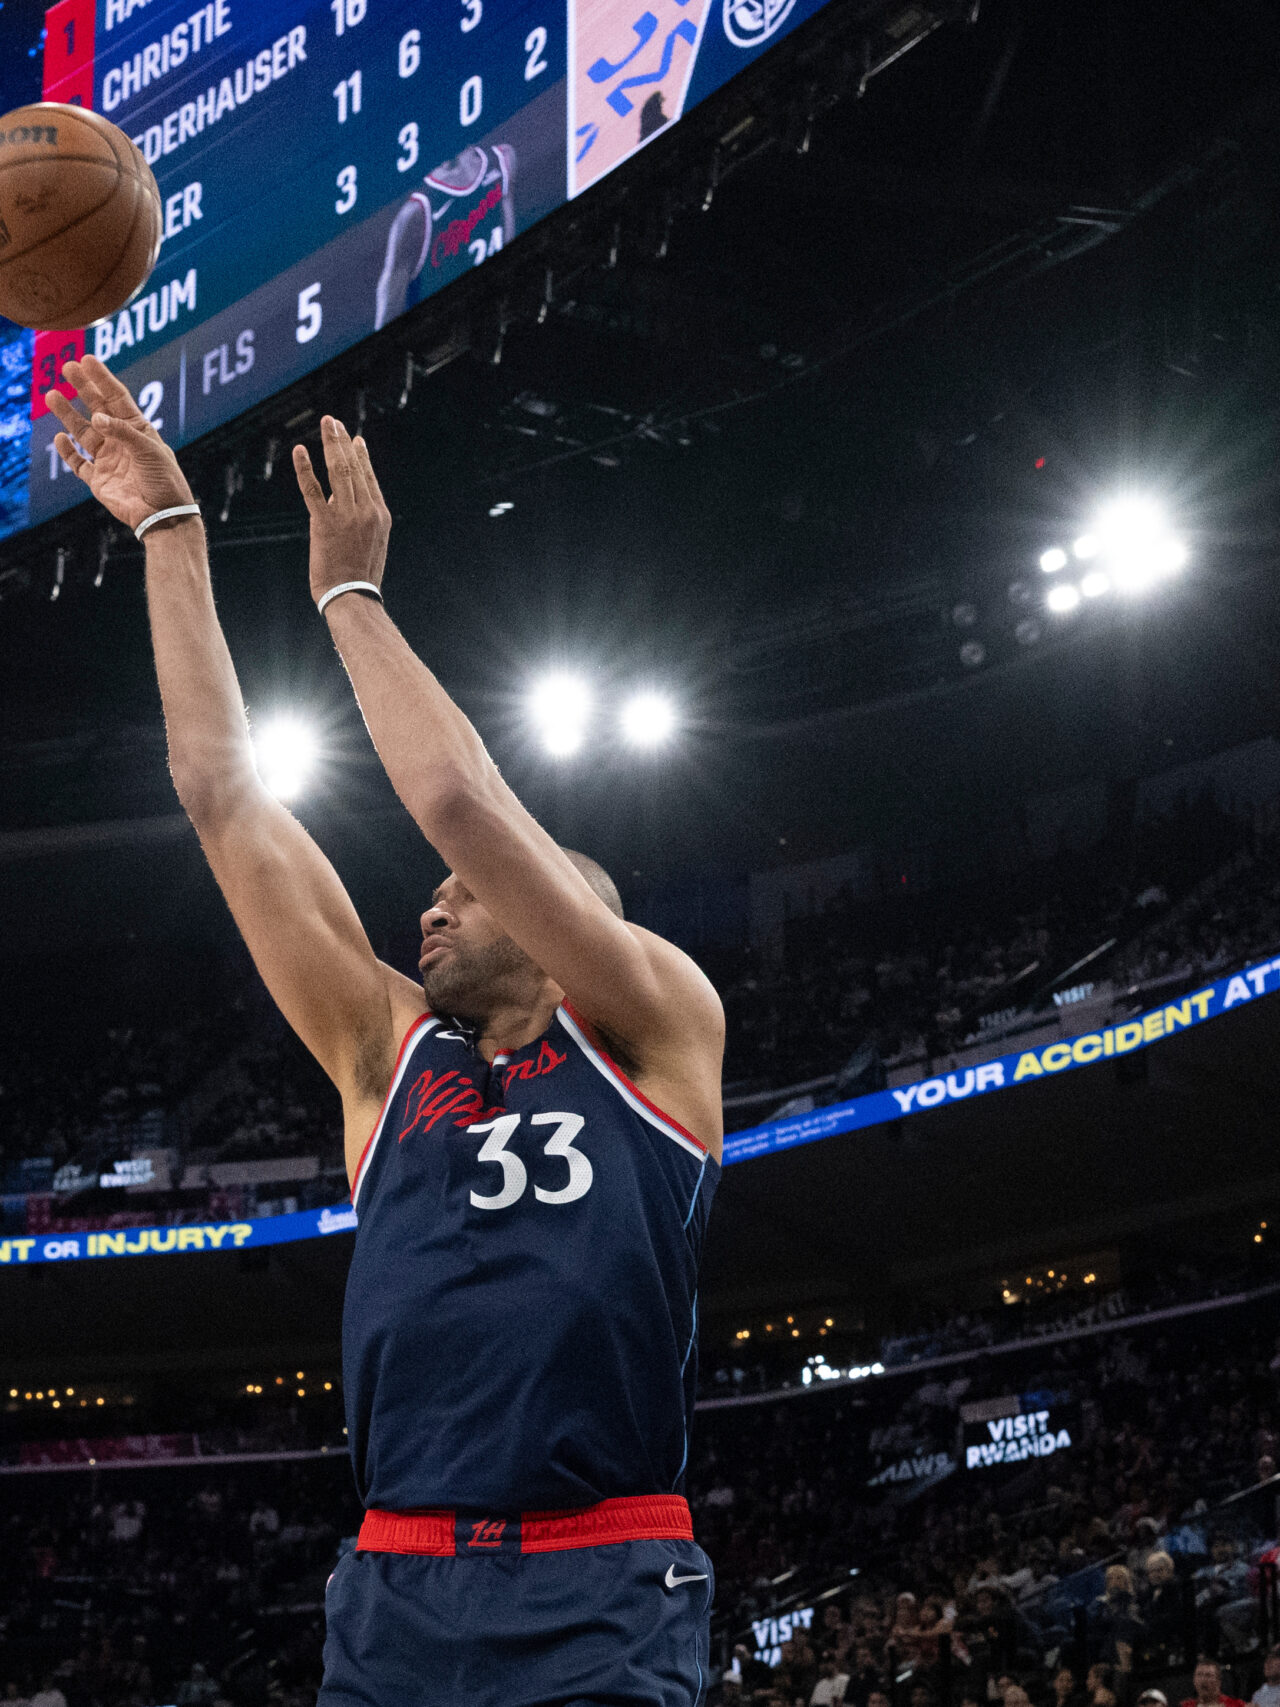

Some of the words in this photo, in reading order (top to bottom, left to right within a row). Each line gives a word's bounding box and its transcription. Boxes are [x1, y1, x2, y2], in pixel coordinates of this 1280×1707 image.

[64, 20, 75, 56] 1
[102, 0, 233, 112] CHRISTIE
[131, 25, 308, 166] DERHAUSER
[161, 181, 204, 244] ER
[333, 69, 362, 124] 11
[398, 28, 421, 79] 6
[93, 268, 197, 363] BATUM
[335, 164, 358, 215] 3
[397, 121, 419, 173] 3
[459, 74, 482, 127] 0
[524, 25, 548, 82] 2
[138, 380, 164, 431] 2
[202, 329, 255, 395] FLS
[295, 282, 322, 344] 5
[892, 1061, 1006, 1114] YOUR
[1013, 988, 1215, 1082] ACCIDENT
[466, 1111, 594, 1210] 33
[43, 1240, 80, 1259] OR
[87, 1223, 253, 1257] INJURY?
[966, 1428, 1072, 1470] RWANDA
[986, 1410, 1050, 1442] VISIT
[752, 1607, 814, 1649] VISIT
